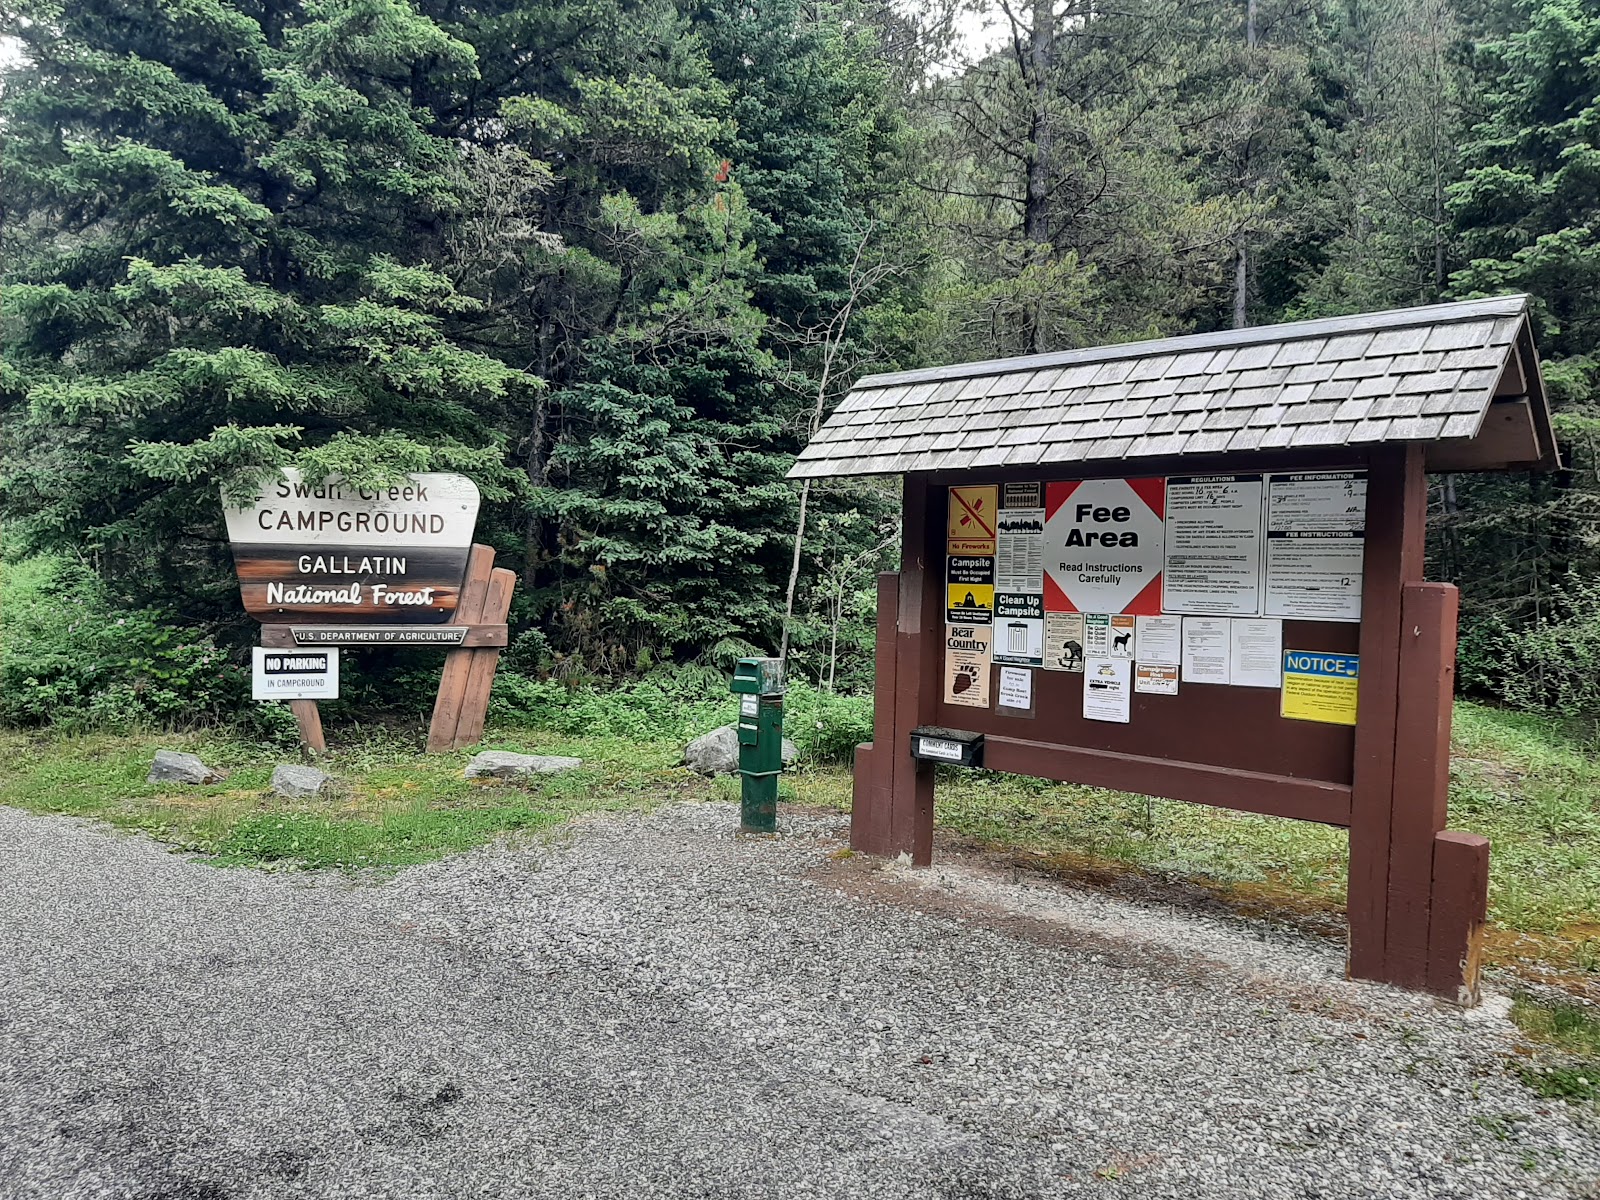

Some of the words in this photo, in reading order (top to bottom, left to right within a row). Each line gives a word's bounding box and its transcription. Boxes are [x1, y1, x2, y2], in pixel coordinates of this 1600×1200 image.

[1223, 486, 1229, 494] 6
[1076, 504, 1131, 523] Fee
[258, 510, 445, 534] CAMPGROUND
[1065, 529, 1138, 547] Area
[299, 556, 406, 574] GALLATIN
[952, 558, 991, 568] Campsite
[1060, 562, 1083, 571] Read
[1086, 563, 1143, 573] Instructions
[1079, 574, 1121, 585] Carefully
[1341, 578, 1351, 586] 12
[267, 582, 362, 605] National
[371, 584, 435, 606] Forest
[1000, 595, 1025, 605] Clean
[1026, 596, 1040, 608] Up
[998, 606, 1040, 617] Campsite
[300, 632, 317, 641] U.S.
[321, 632, 382, 641] DEPARTMENT
[384, 632, 395, 641] OF
[400, 632, 460, 641] AGRICULTURE
[952, 627, 974, 638] Bear
[947, 638, 988, 654] Country
[266, 658, 282, 670] NO
[283, 658, 326, 670] PARKING
[1288, 656, 1346, 673] NOTICE
[268, 680, 275, 688] IN
[277, 679, 325, 688] CAMPGROUND
[923, 740, 943, 748] COMMENT
[944, 742, 958, 751] CARDS
